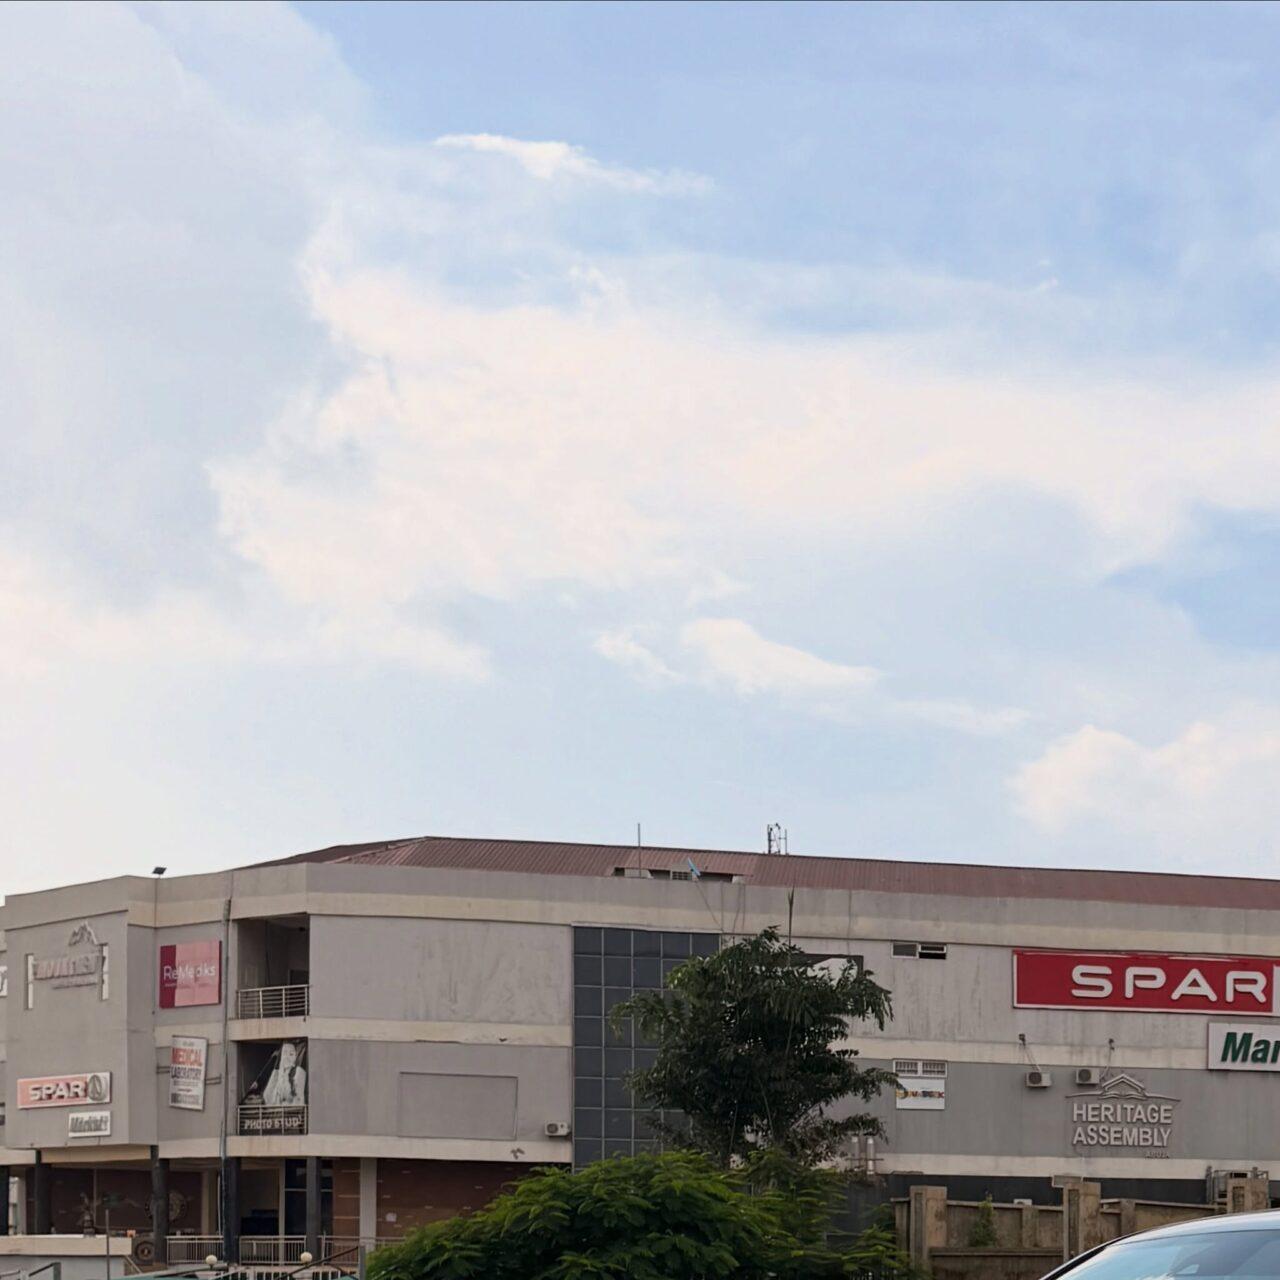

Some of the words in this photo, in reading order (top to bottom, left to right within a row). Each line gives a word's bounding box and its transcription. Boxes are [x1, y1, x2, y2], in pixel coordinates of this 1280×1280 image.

[1071, 964, 1268, 1003] SPAR
[29, 1080, 87, 1101] SPAR
[1073, 1102, 1173, 1124] HERITAGE
[244, 1119, 273, 1130] PHOTO
[1073, 1124, 1171, 1147] ASSEMBLY
